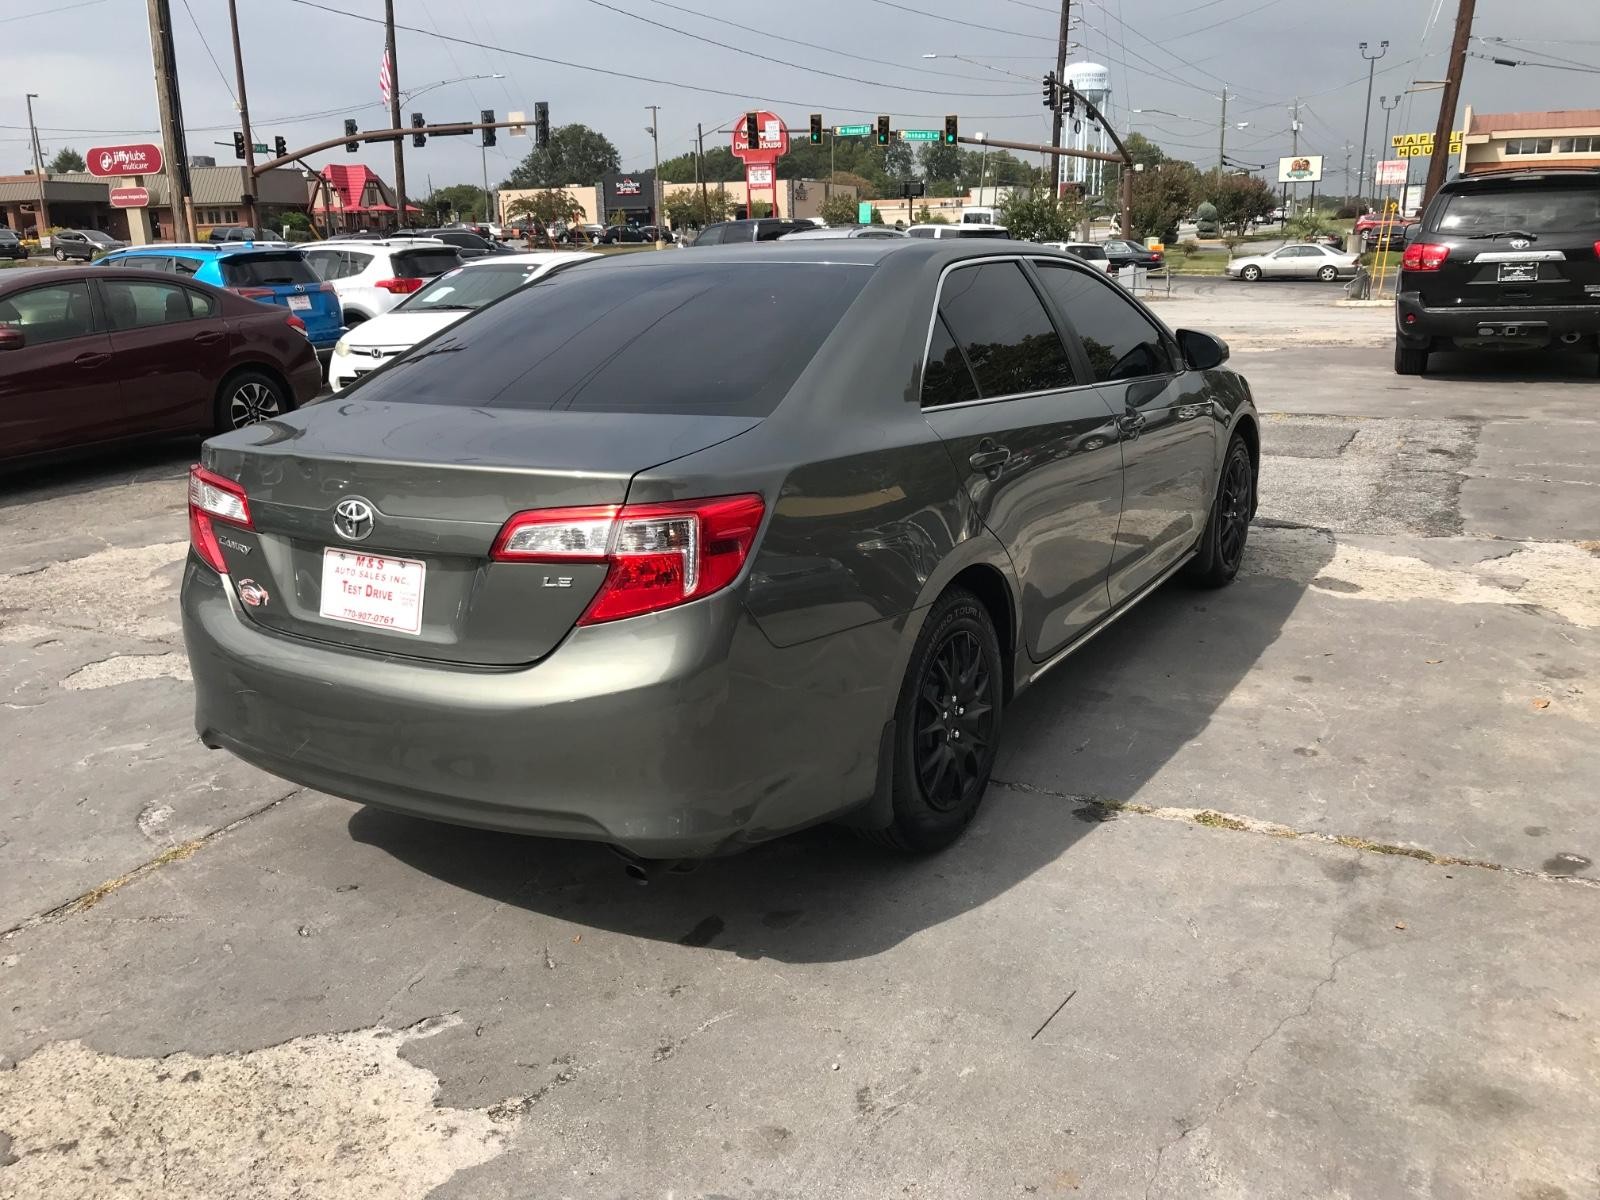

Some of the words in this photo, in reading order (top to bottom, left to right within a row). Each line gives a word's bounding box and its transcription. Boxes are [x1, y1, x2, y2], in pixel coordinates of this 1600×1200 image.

[759, 141, 782, 149] House
[1399, 144, 1459, 155] HOUE
[356, 556, 366, 567] M
[377, 559, 385, 570] S
[335, 566, 356, 576] AUTO
[359, 570, 387, 583] SALES
[389, 575, 410, 586] INC.
[543, 576, 573, 587] LE
